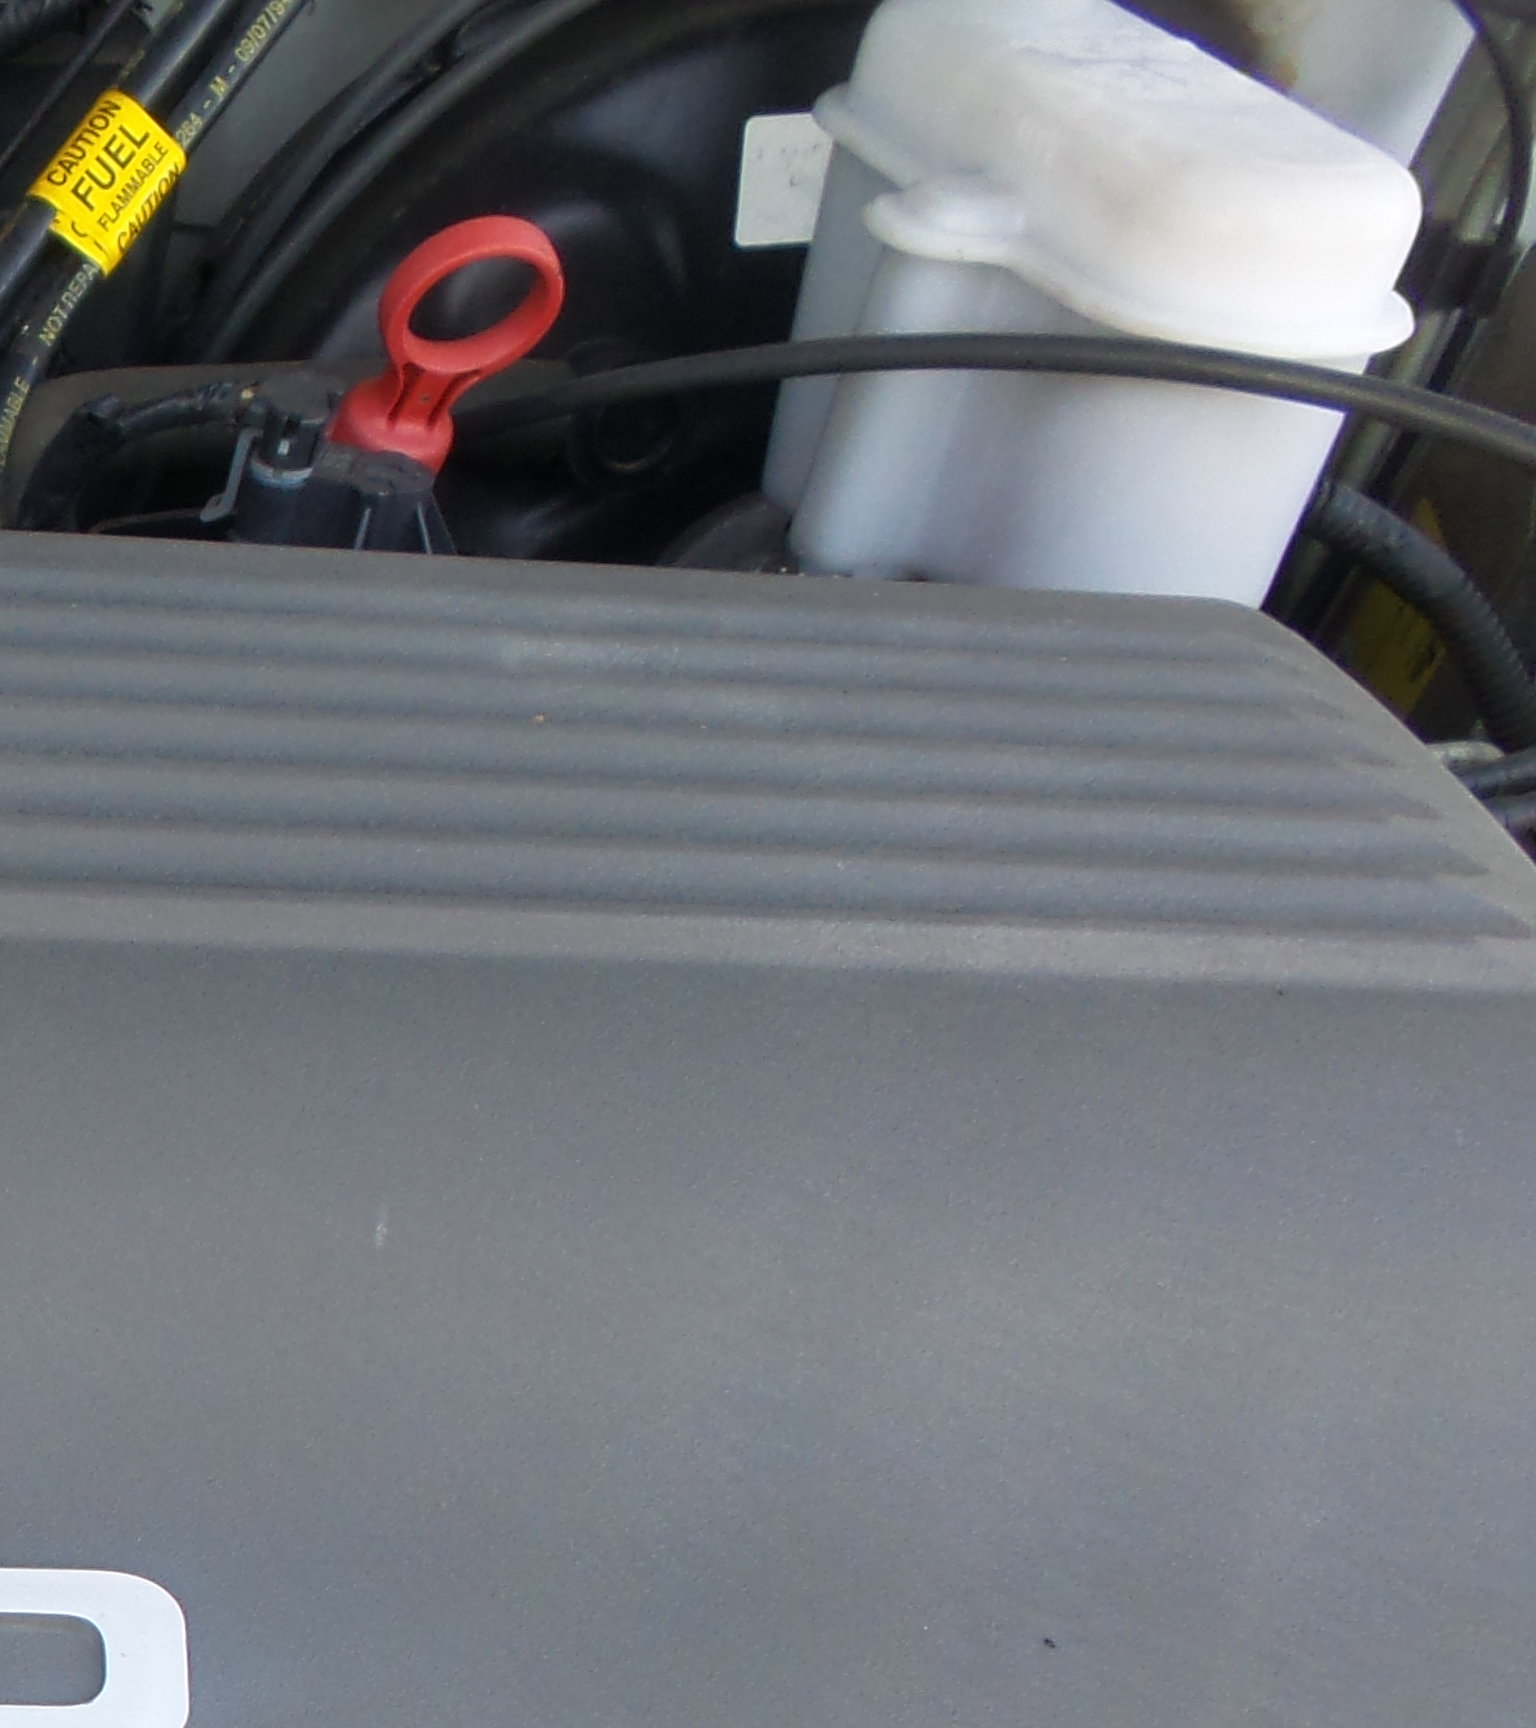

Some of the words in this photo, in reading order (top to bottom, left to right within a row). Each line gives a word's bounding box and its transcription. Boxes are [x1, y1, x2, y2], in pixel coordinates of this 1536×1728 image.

[47, 100, 123, 186] CAUTION
[71, 125, 150, 212] FUEL
[96, 142, 169, 232] FLAMMABLE
[117, 163, 181, 253] CAUTION
[61, 262, 100, 307] REPA
